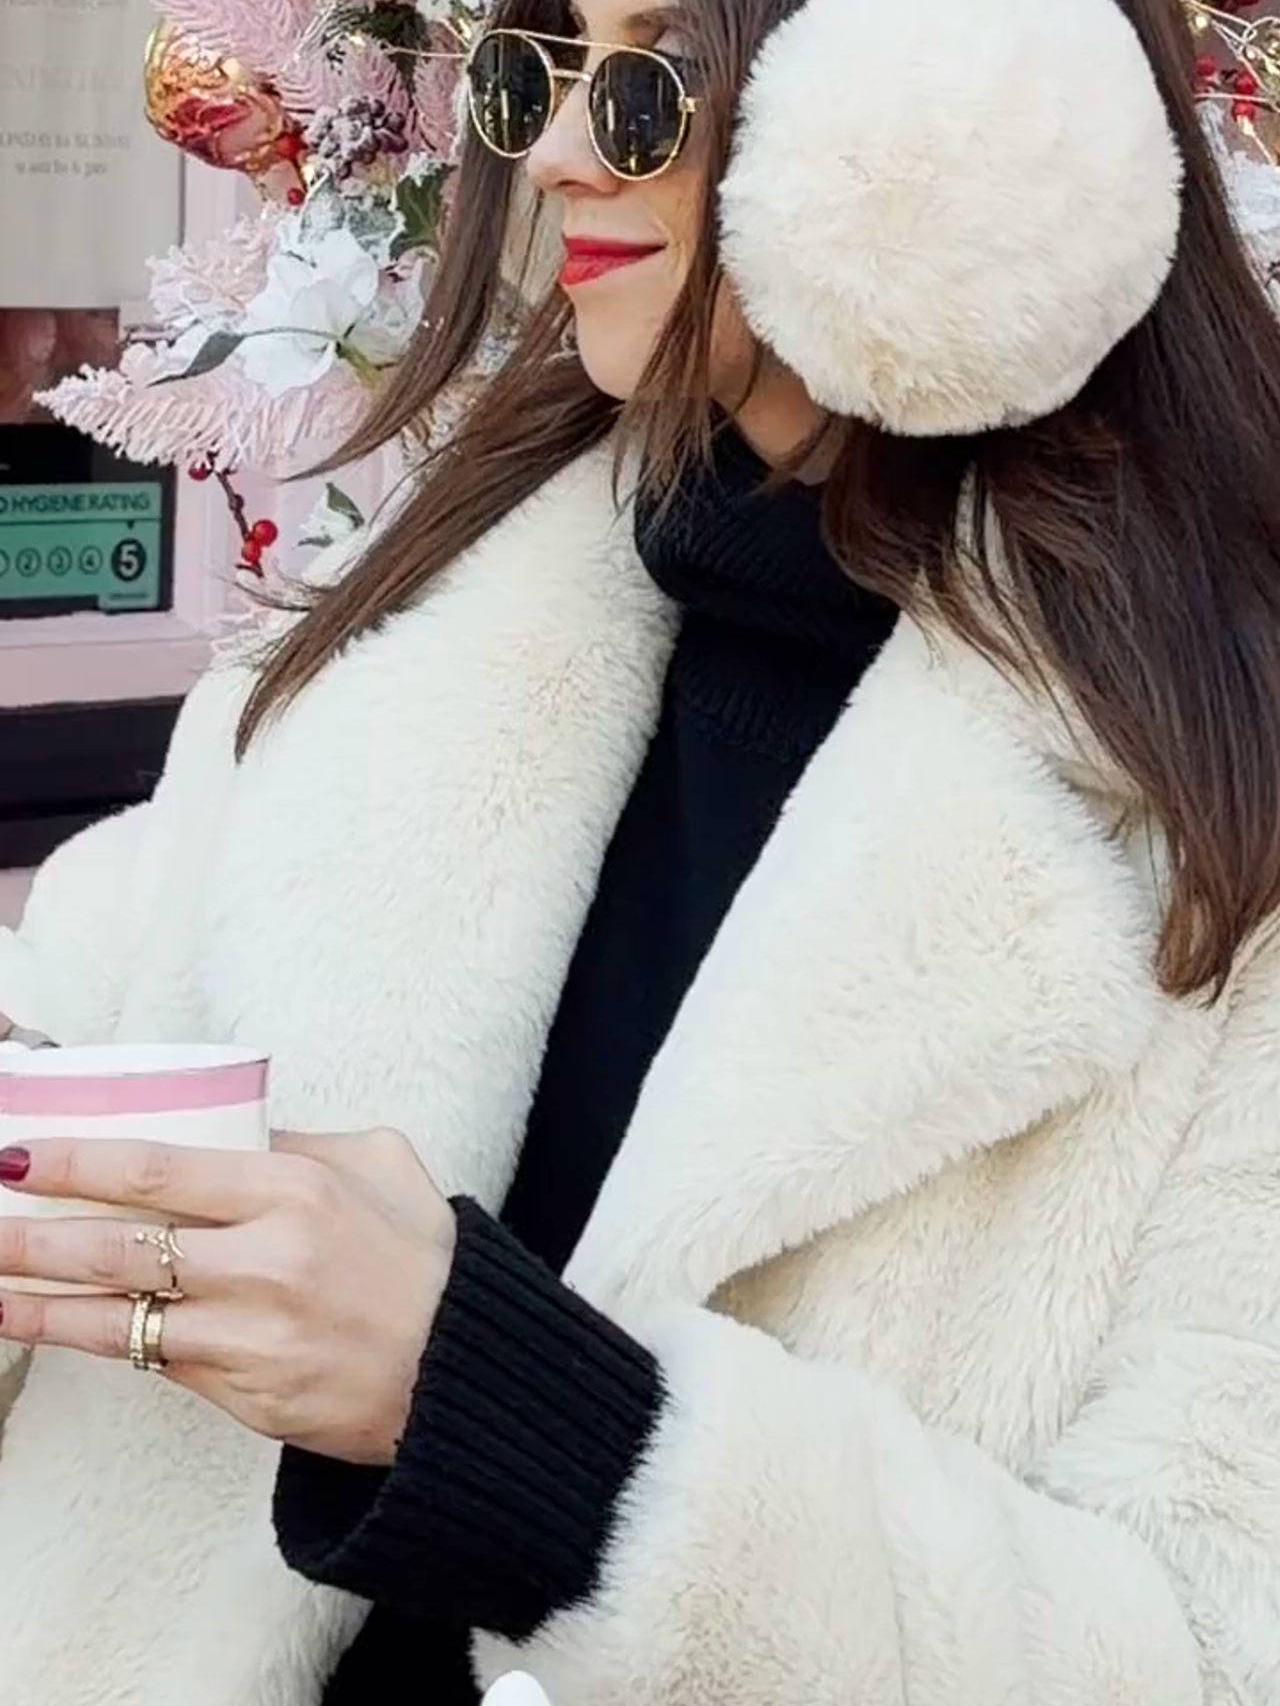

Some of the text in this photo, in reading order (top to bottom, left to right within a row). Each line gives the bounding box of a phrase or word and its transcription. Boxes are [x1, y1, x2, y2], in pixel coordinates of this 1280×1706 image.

[11, 494, 86, 513] HYGIENE
[87, 492, 151, 511] RATING
[118, 543, 139, 578] 5
